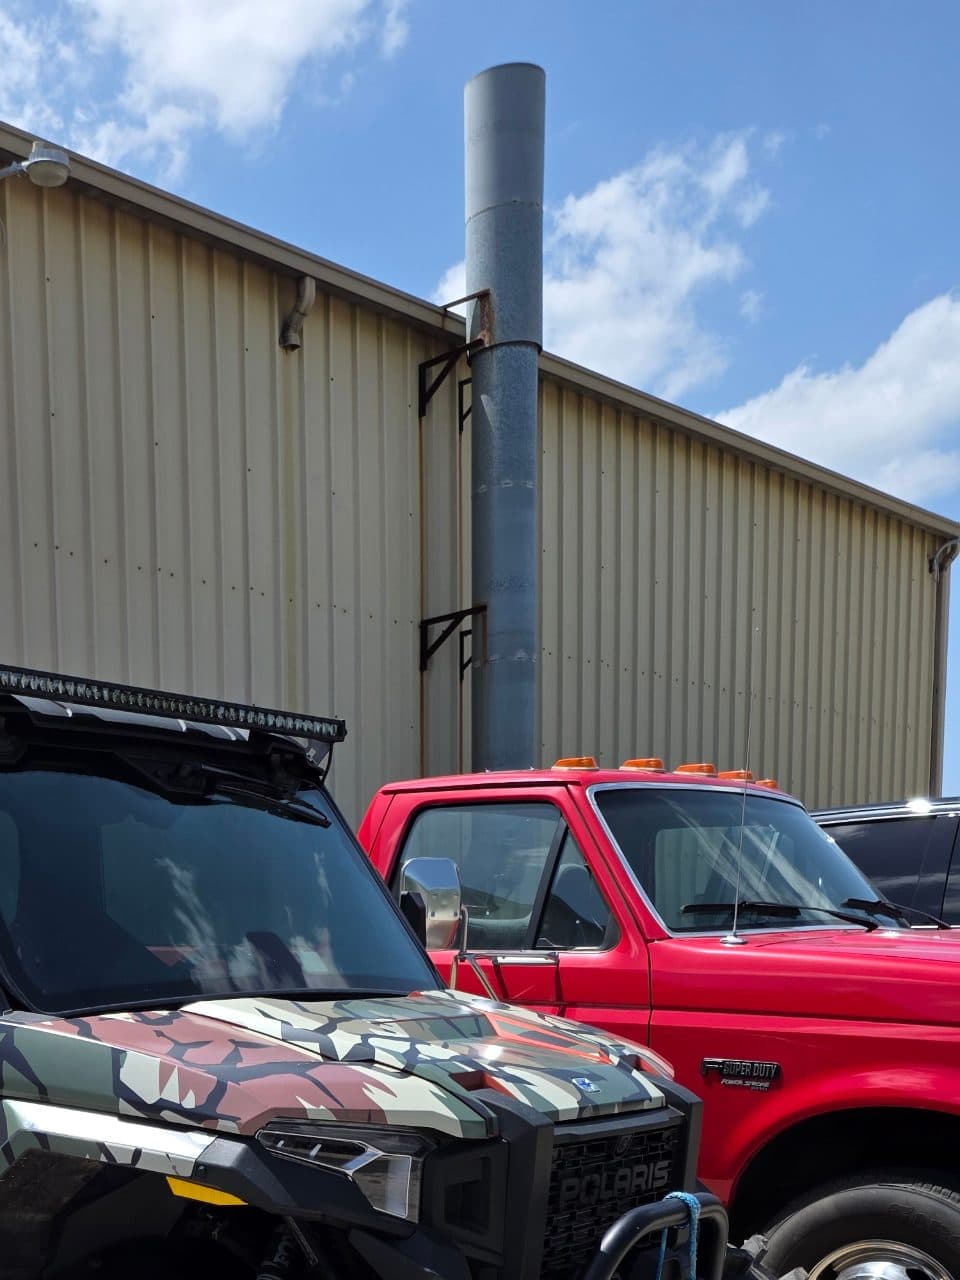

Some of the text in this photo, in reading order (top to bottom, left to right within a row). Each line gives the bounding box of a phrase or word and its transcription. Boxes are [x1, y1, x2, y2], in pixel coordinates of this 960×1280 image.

[723, 1061, 752, 1075] SUPER
[753, 1063, 777, 1078] DUTY
[559, 1160, 672, 1207] POLARIS
